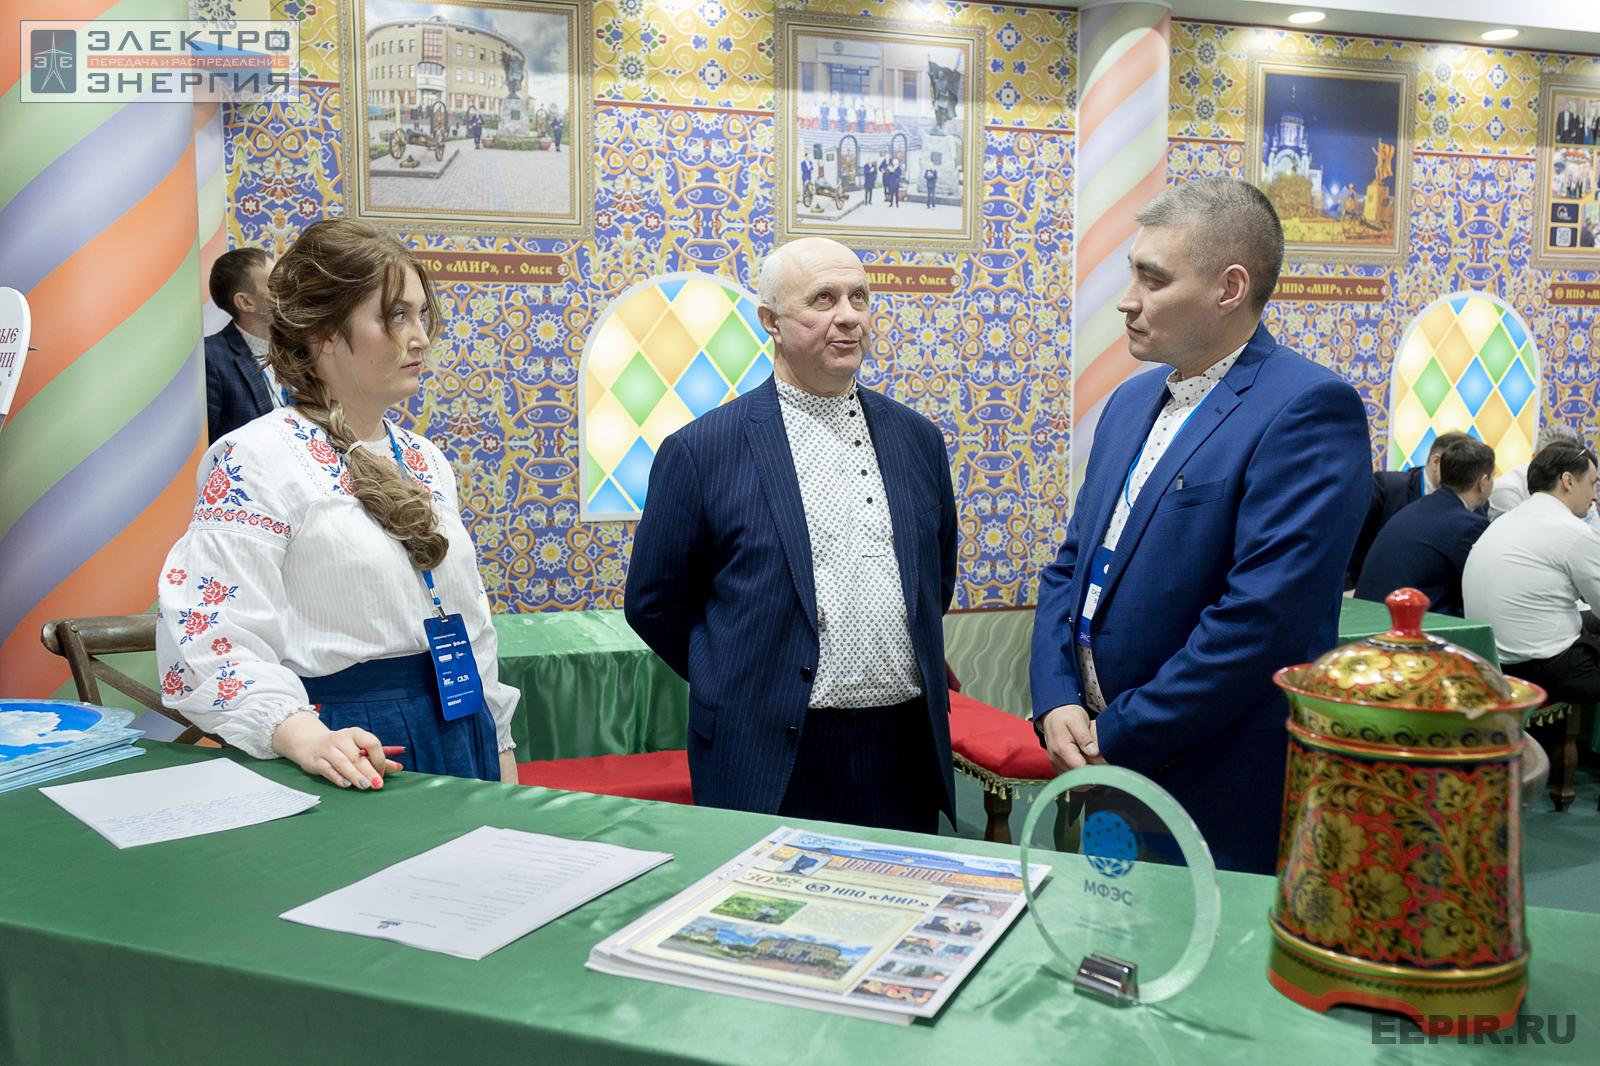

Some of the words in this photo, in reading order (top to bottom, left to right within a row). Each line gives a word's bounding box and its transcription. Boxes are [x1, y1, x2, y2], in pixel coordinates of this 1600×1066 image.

[519, 263, 553, 275] Омск
[919, 273, 947, 286] Омск
[1356, 284, 1379, 296] Омск
[832, 887, 867, 898] НПО
[1084, 879, 1133, 906] МФЭС
